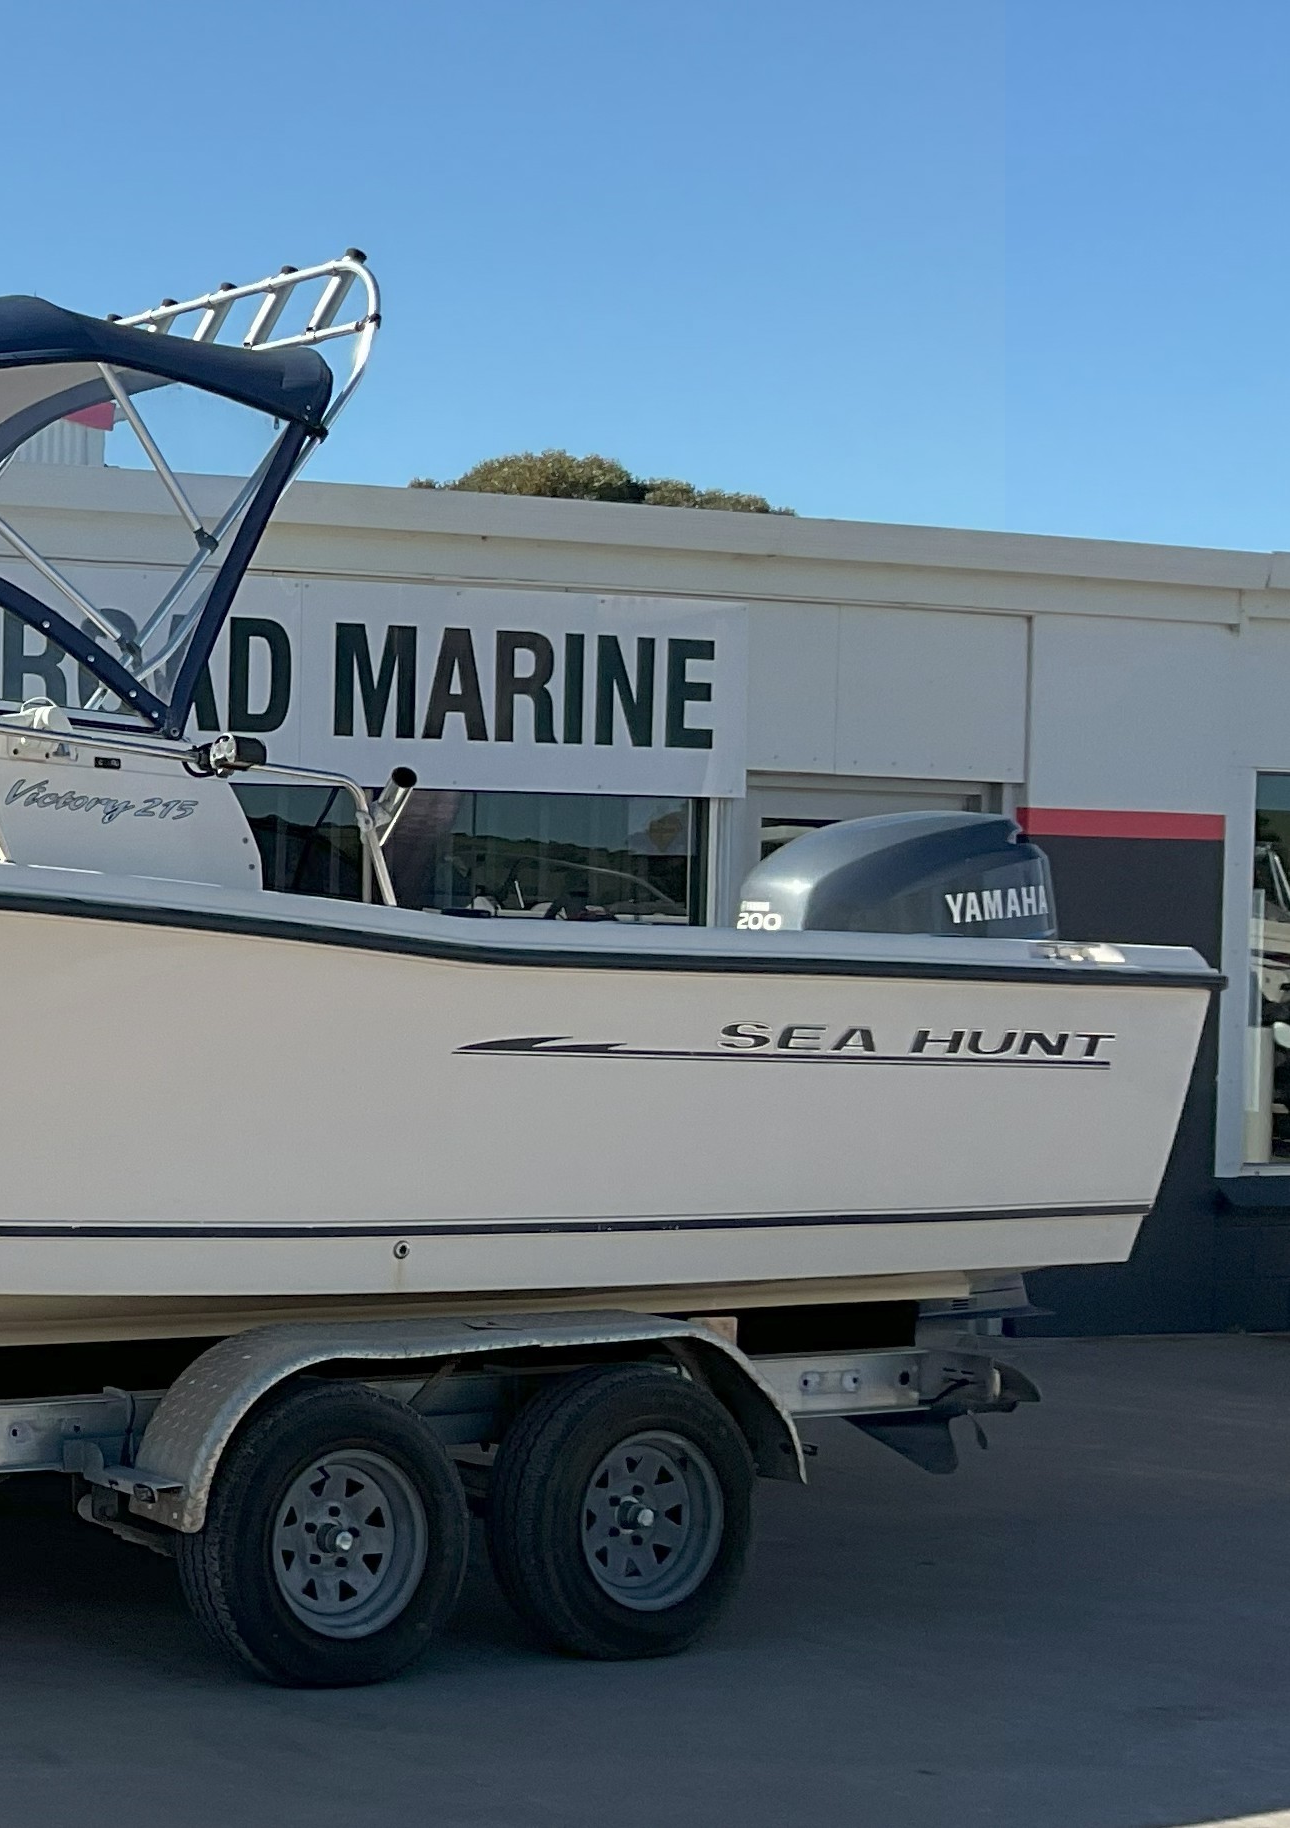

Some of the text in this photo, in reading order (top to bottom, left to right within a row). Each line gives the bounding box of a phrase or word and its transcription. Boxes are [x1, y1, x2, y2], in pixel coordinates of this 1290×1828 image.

[333, 622, 716, 749] MARINE
[5, 778, 199, 824] Victory 215
[736, 912, 782, 931] 200
[944, 885, 1049, 924] YAMAHA
[717, 1022, 1118, 1059] SEA HUNT
